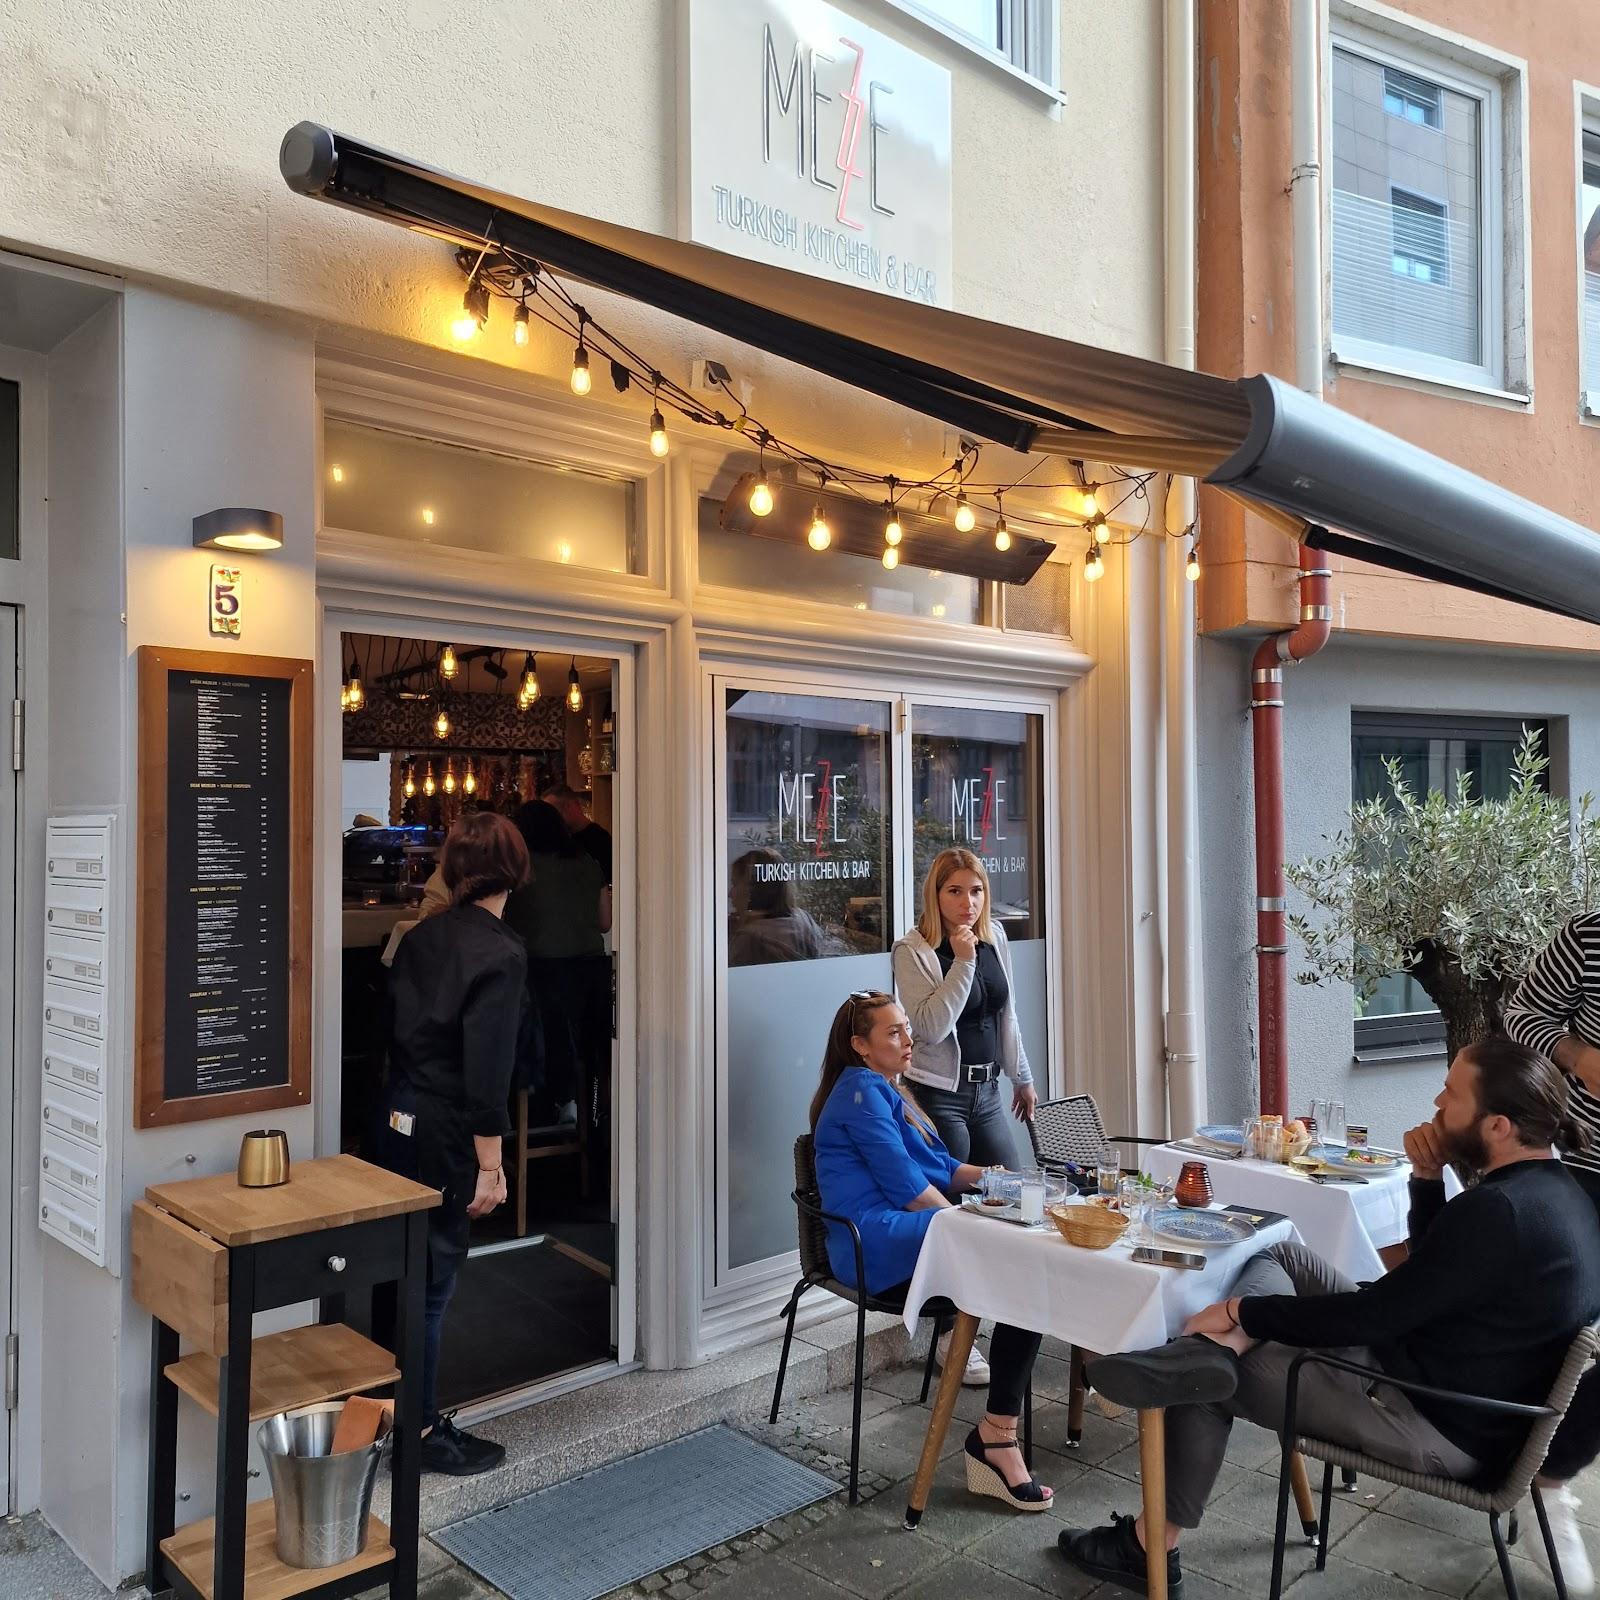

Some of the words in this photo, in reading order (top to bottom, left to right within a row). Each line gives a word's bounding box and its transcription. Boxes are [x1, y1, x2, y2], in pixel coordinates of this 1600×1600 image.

[712, 184, 797, 250] TURKISH
[804, 220, 880, 283] KITCHEN
[885, 255, 899, 289] &
[903, 260, 937, 304] BAR
[215, 584, 239, 615] 5
[754, 863, 796, 882] TURKISH
[800, 861, 839, 880] KITCHEN
[842, 861, 850, 879] &
[852, 861, 870, 878] BAR
[1003, 857, 1009, 873] &
[1011, 857, 1026, 872] BAR
